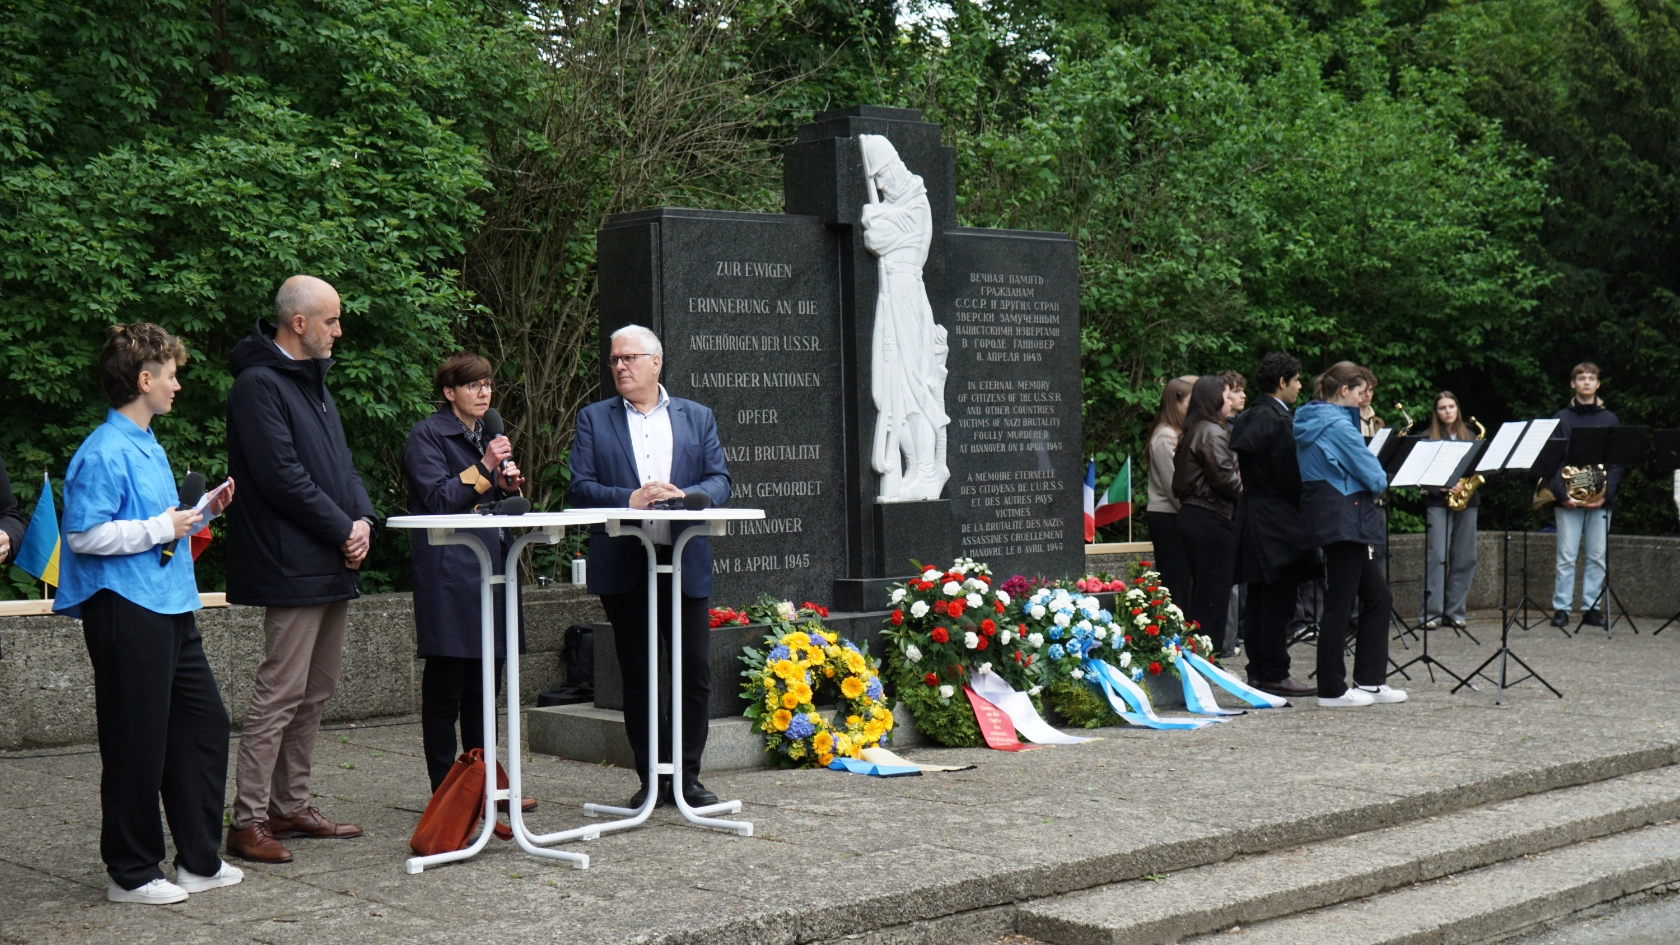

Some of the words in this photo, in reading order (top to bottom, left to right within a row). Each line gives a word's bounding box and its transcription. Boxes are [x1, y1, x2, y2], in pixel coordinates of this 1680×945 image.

[716, 261, 741, 276] ZUR
[745, 262, 792, 278] EWIGEN
[970, 273, 1004, 284] ВЕЧНАЯ
[1009, 275, 1044, 285] ПАМЯТЬ
[981, 286, 1034, 298] ГРАЖДАНАМ
[689, 298, 770, 314] ERINNERUNG
[777, 300, 791, 314] AN
[798, 300, 818, 315] DIE
[991, 300, 997, 310] И
[1000, 300, 1031, 311] ДРУГИХ
[1034, 302, 1060, 312] СТРАН
[1000, 313, 1060, 325] ЗАМУЧЕННЫМ
[956, 325, 1013, 336] НАЦИСТСКИМИ
[1016, 327, 1060, 337] ИЗВЕРГАМИ
[690, 334, 758, 351] ANGEHÖRIGEN
[762, 336, 780, 351] DER
[962, 339, 968, 348] В
[974, 339, 1007, 349] ГОРОДЕ
[1014, 340, 1055, 350] ГАННОВЕР
[987, 353, 1020, 362] АПРЕЛЯ
[1023, 353, 1042, 362] 1945
[763, 372, 820, 387] NATIONEN
[968, 381, 976, 390] IN
[980, 381, 1014, 390] ETERNAL
[1018, 381, 1050, 391] MEMORY
[958, 394, 968, 403] OF
[972, 393, 1006, 403] CITIZENS
[1008, 393, 1016, 402] OF
[1020, 393, 1032, 402] THE
[738, 409, 778, 424] OPFER
[966, 406, 981, 416] AND
[985, 406, 1010, 415] OTHER
[1013, 405, 1055, 415] COUNTRIES
[959, 419, 990, 428] VICTIMS
[993, 418, 1001, 428] OF
[1004, 418, 1021, 428] NAZI
[1023, 417, 1061, 428] BRUTALITY
[974, 431, 1004, 441] FOULLY
[1007, 430, 1048, 440] MURDERED
[723, 446, 750, 462] NAZI
[960, 444, 968, 454] AT
[971, 443, 1006, 453] HANNOVER
[1008, 442, 1018, 452] ON
[1020, 443, 1024, 452] 8
[1026, 442, 1045, 451] APRIL
[1047, 442, 1063, 451] 1945
[976, 471, 1012, 482] MÉMOIRE
[757, 481, 822, 498] GEMORDET
[961, 486, 976, 495] DES
[980, 484, 1016, 495] CITOYENS
[1018, 483, 1028, 492] DE
[972, 498, 981, 507] ET
[985, 497, 1000, 507] DES
[1004, 495, 1032, 506] AUTRES
[1035, 494, 1053, 505] PAYS
[996, 508, 1031, 519] VICTIMES
[740, 518, 802, 536] HANNOVER
[962, 524, 972, 534] DE
[974, 523, 984, 533] LA
[1026, 519, 1041, 529] DES
[1043, 518, 1064, 528] NAZIS
[1011, 530, 1064, 542] CRUELLEMENT
[970, 547, 1004, 558] HANOVRE
[1006, 546, 1015, 555] LE
[1017, 546, 1022, 554] 8
[1025, 544, 1045, 554] AVRIL
[1047, 543, 1064, 552] 1945
[712, 558, 730, 575] AM
[746, 555, 781, 572] APRIL
[785, 554, 810, 569] 1945
